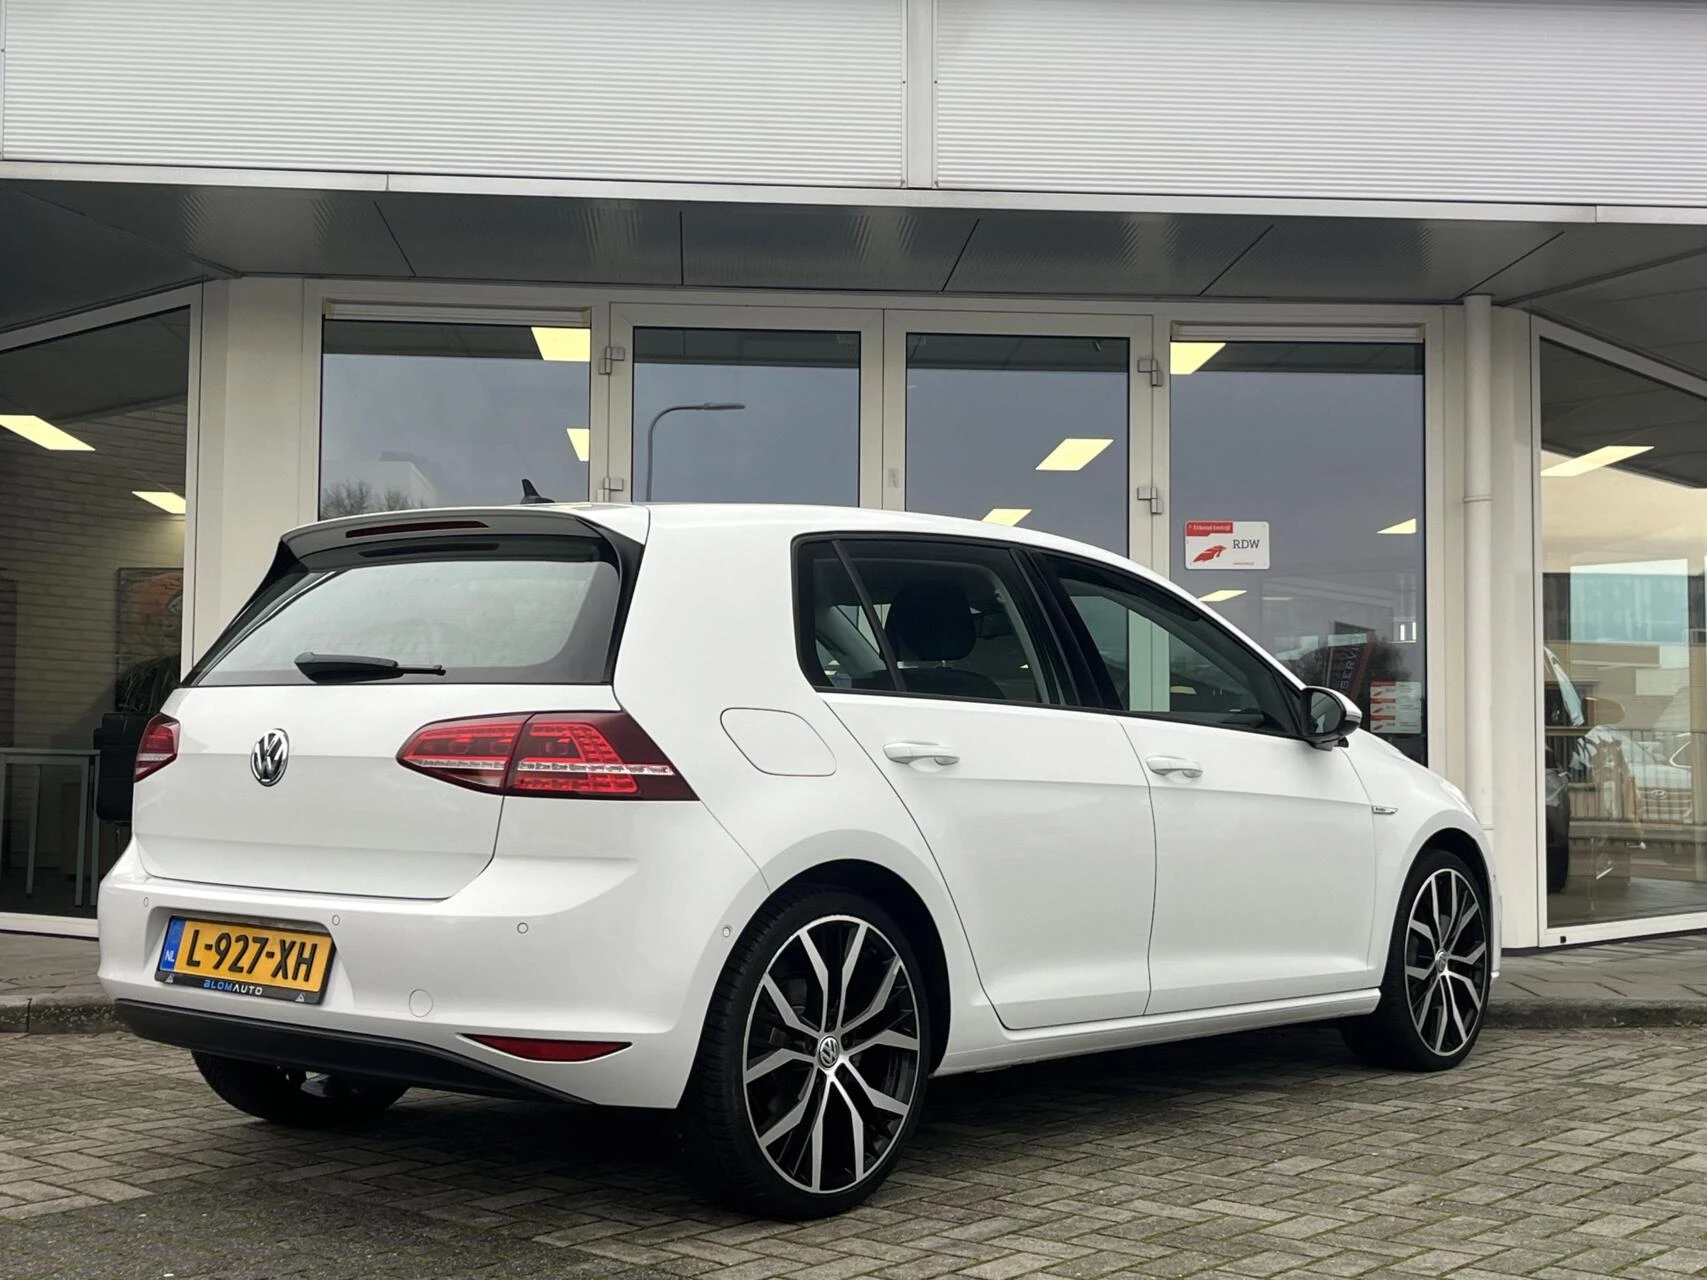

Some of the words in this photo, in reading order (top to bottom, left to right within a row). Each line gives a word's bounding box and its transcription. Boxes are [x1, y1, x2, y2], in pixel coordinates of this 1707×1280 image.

[1233, 539, 1260, 549] RDW
[164, 950, 175, 962] NL
[186, 929, 318, 982] L-927-XH
